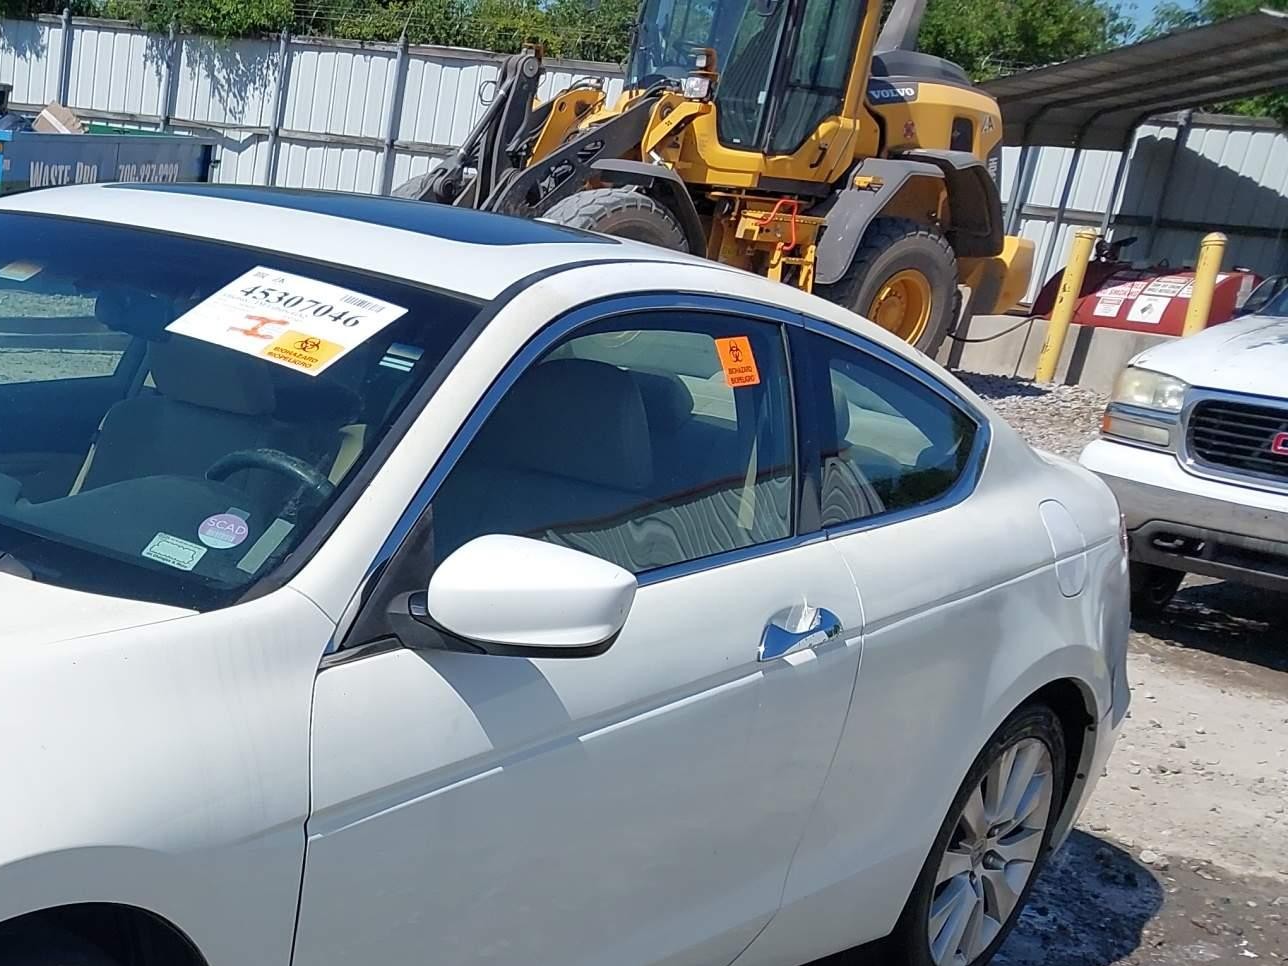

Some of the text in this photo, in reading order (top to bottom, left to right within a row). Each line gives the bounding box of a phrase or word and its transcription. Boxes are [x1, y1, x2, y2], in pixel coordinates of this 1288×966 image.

[870, 87, 915, 99] VOLVO
[240, 285, 368, 328] 45307046
[273, 346, 319, 363] BIOHAZARD
[207, 518, 246, 535] SCAD
